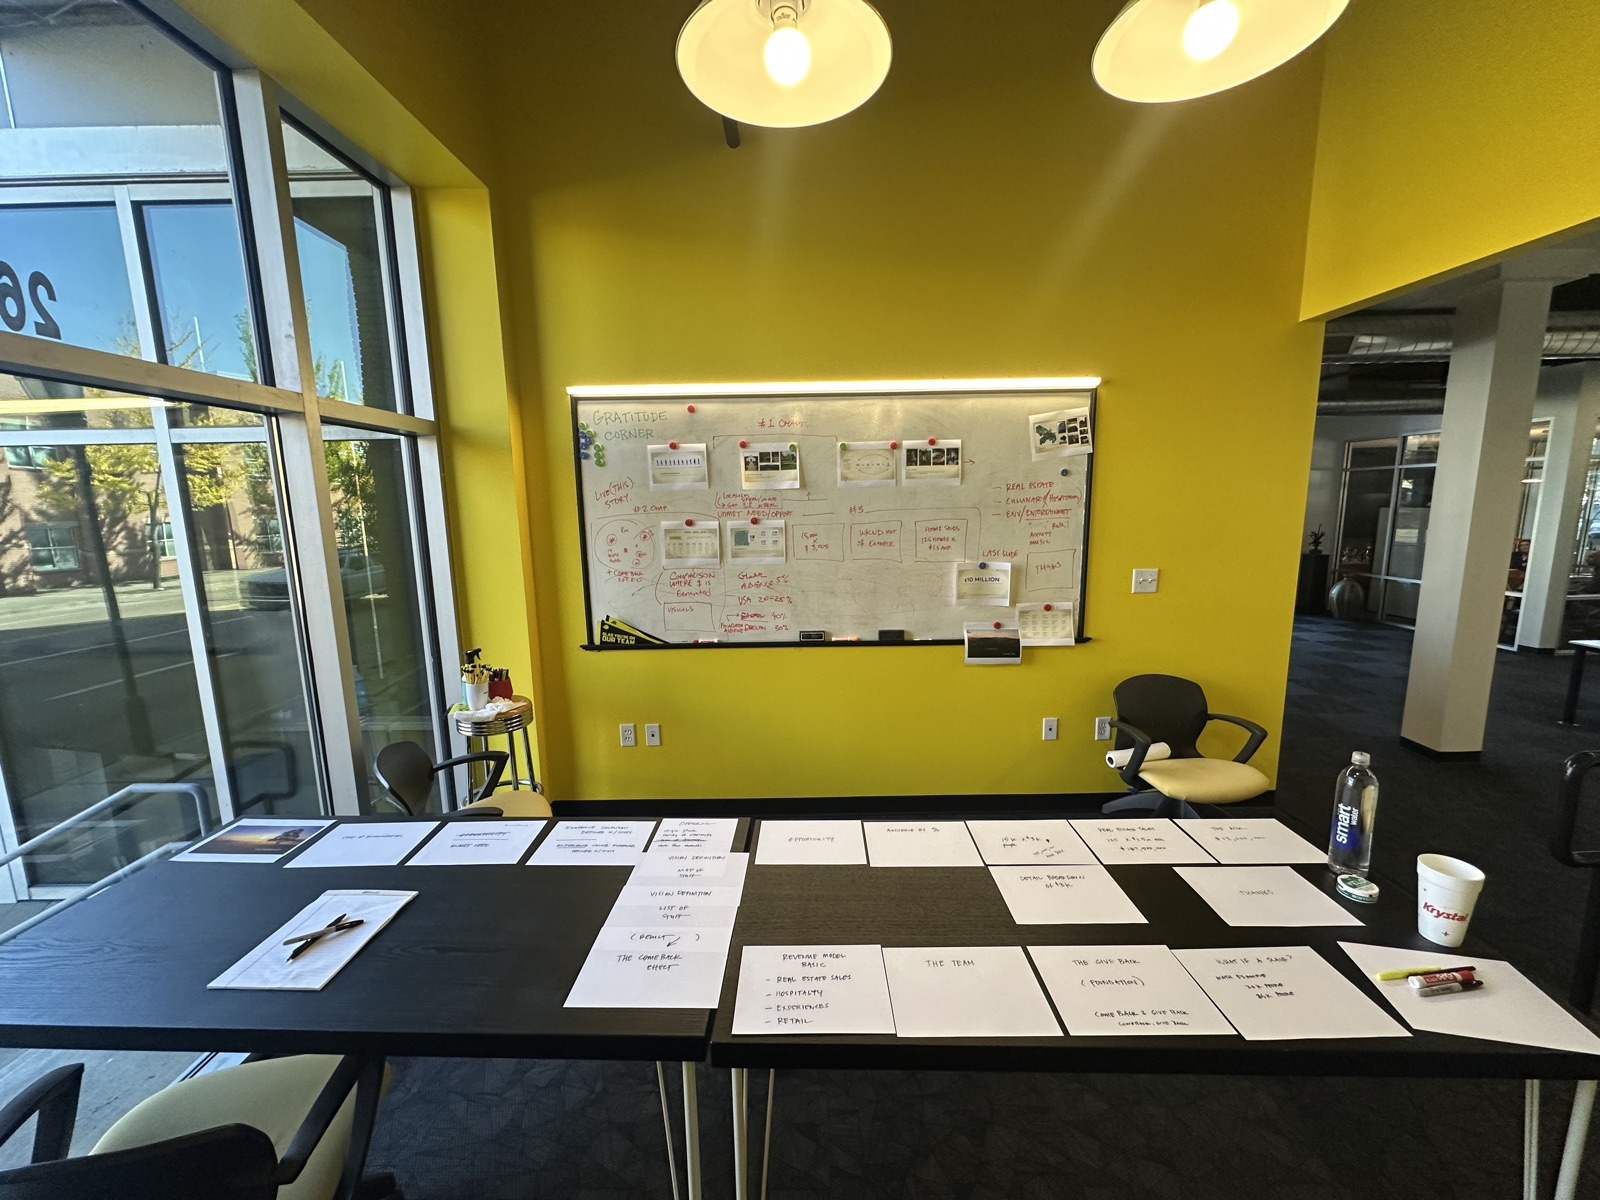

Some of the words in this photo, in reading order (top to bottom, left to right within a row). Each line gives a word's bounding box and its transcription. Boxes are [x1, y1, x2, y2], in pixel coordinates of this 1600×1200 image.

[593, 409, 668, 426] GRATITUDE
[604, 428, 654, 441] CORNER
[1005, 482, 1025, 492] REAL
[1028, 480, 1054, 490] ESTATE
[1350, 807, 1359, 826] water
[1336, 803, 1351, 844] smart
[650, 889, 674, 898] VISION
[1422, 901, 1469, 922] Krystal
[617, 953, 633, 963] THE
[926, 959, 945, 967] THE
[951, 959, 976, 967] TEAM
[1072, 959, 1089, 967] THE
[776, 975, 797, 983] REAL
[830, 973, 852, 981] SALES
[776, 1003, 830, 1012] EXPERIENCES
[777, 1017, 814, 1025] RETAIL
